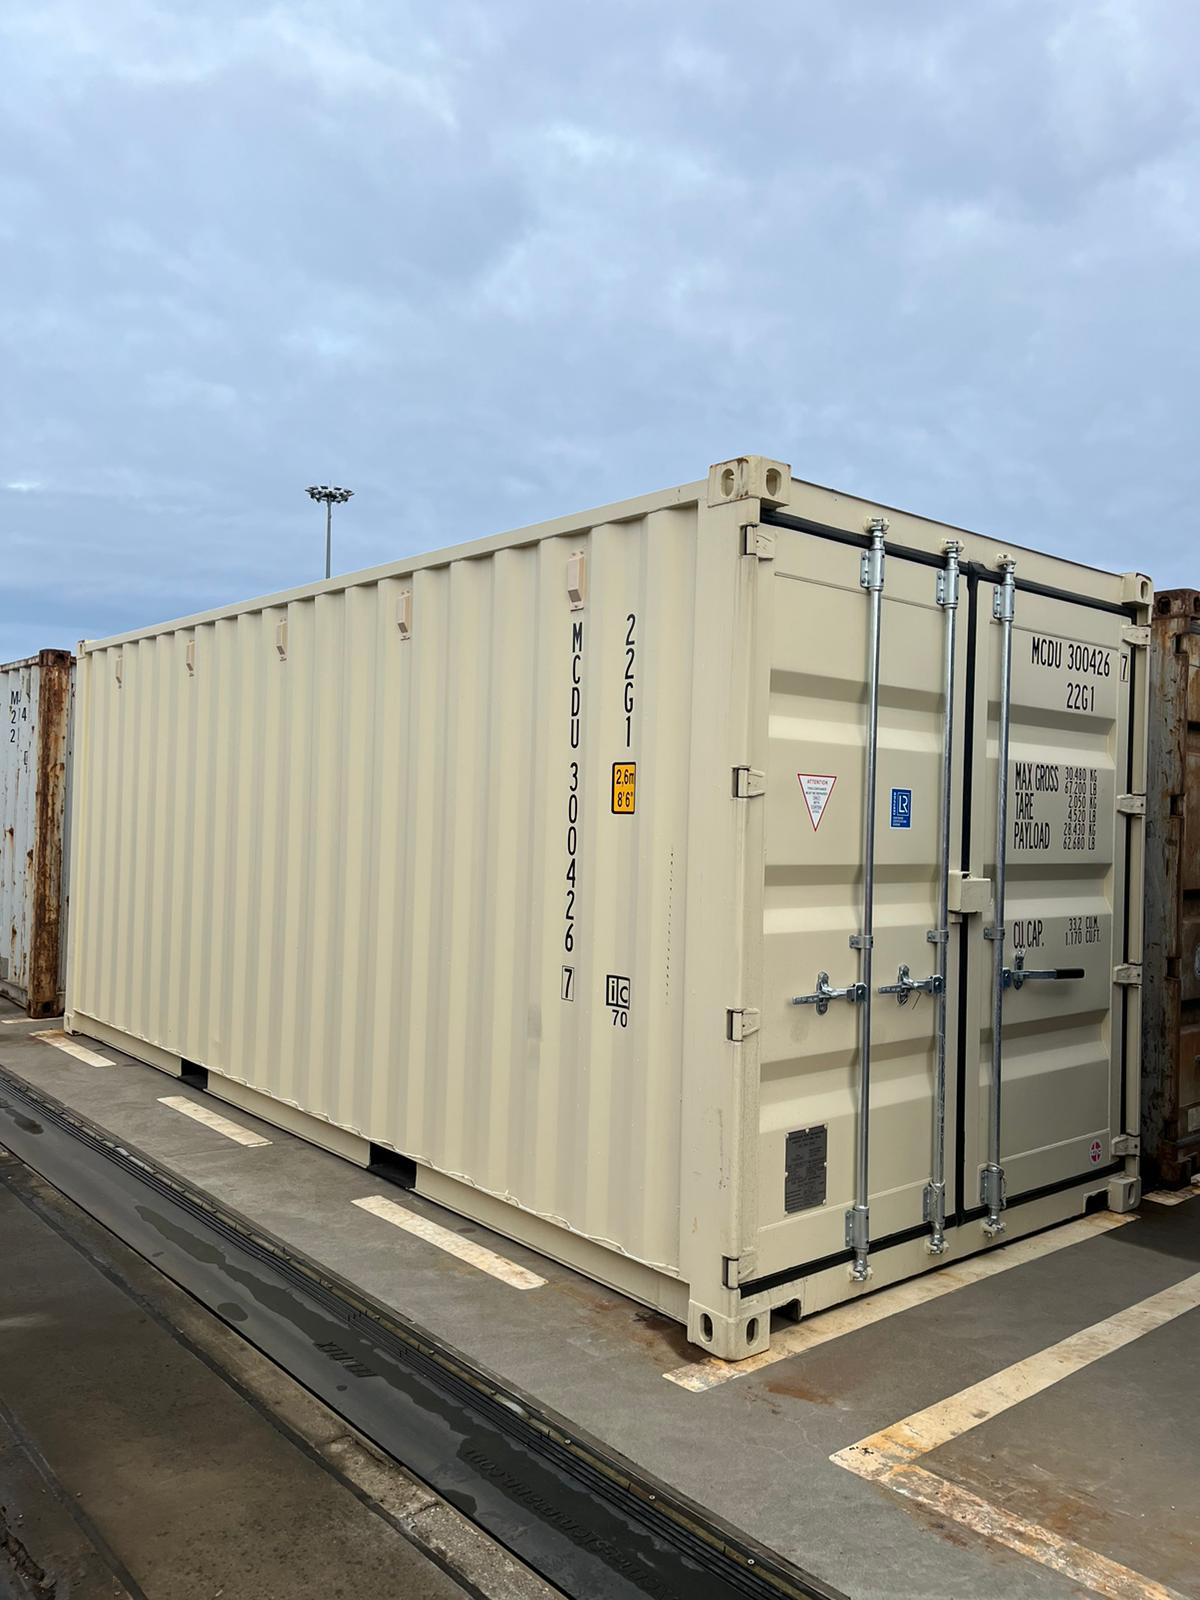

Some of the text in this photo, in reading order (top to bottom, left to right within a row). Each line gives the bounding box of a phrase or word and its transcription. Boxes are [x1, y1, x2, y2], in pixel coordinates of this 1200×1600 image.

[1031, 636, 1128, 680] MCDU 300426 7
[624, 613, 636, 747] 22G1
[1066, 682, 1095, 712] 22G1
[1015, 762, 1033, 791] MAX
[1035, 764, 1059, 792] GROSS
[1089, 769, 1097, 782] KG
[1089, 782, 1097, 796] LB
[564, 622, 583, 998] MCDU 300426 7
[1015, 791, 1034, 820] TARE
[1089, 796, 1097, 809] KG
[1088, 809, 1096, 823] LB
[1013, 821, 1050, 850] PAYLOAD
[1088, 823, 1096, 836] KG
[1087, 836, 1096, 850] LB
[1026, 919, 1045, 948] CAP.
[611, 1008, 628, 1028] 70
